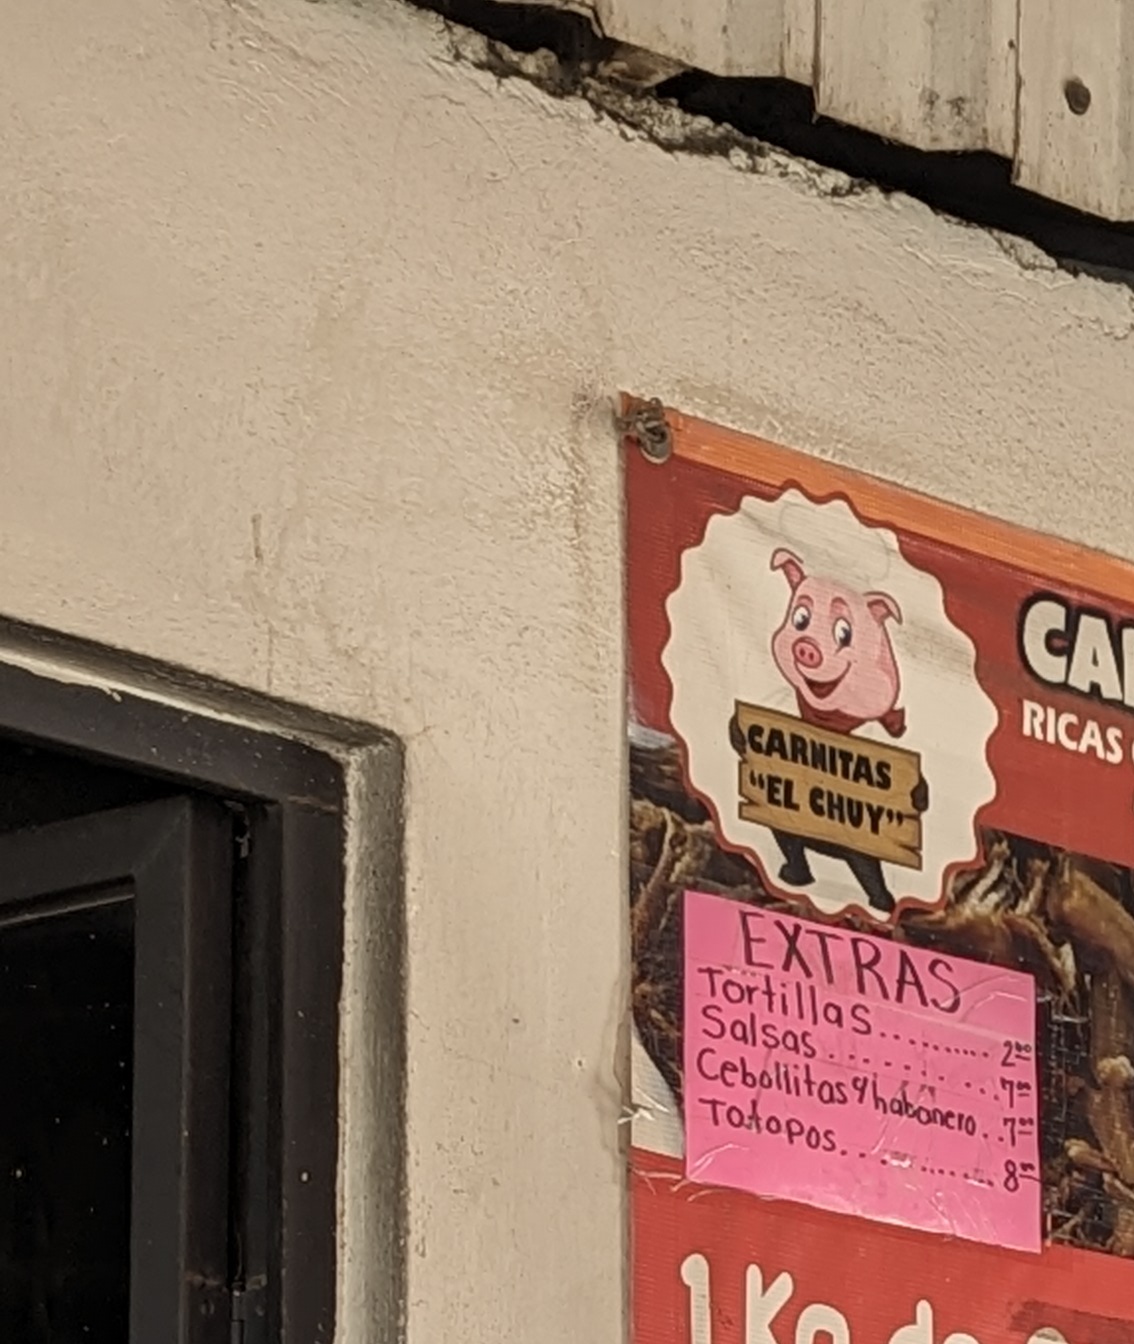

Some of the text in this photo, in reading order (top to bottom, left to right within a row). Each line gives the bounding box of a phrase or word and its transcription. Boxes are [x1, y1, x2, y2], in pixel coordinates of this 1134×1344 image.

[748, 724, 892, 791] CARNITAS
[1022, 700, 1123, 765] RICAS
[740, 910, 962, 1014] EXTRAS
[697, 1048, 848, 1104] Cebollitas
